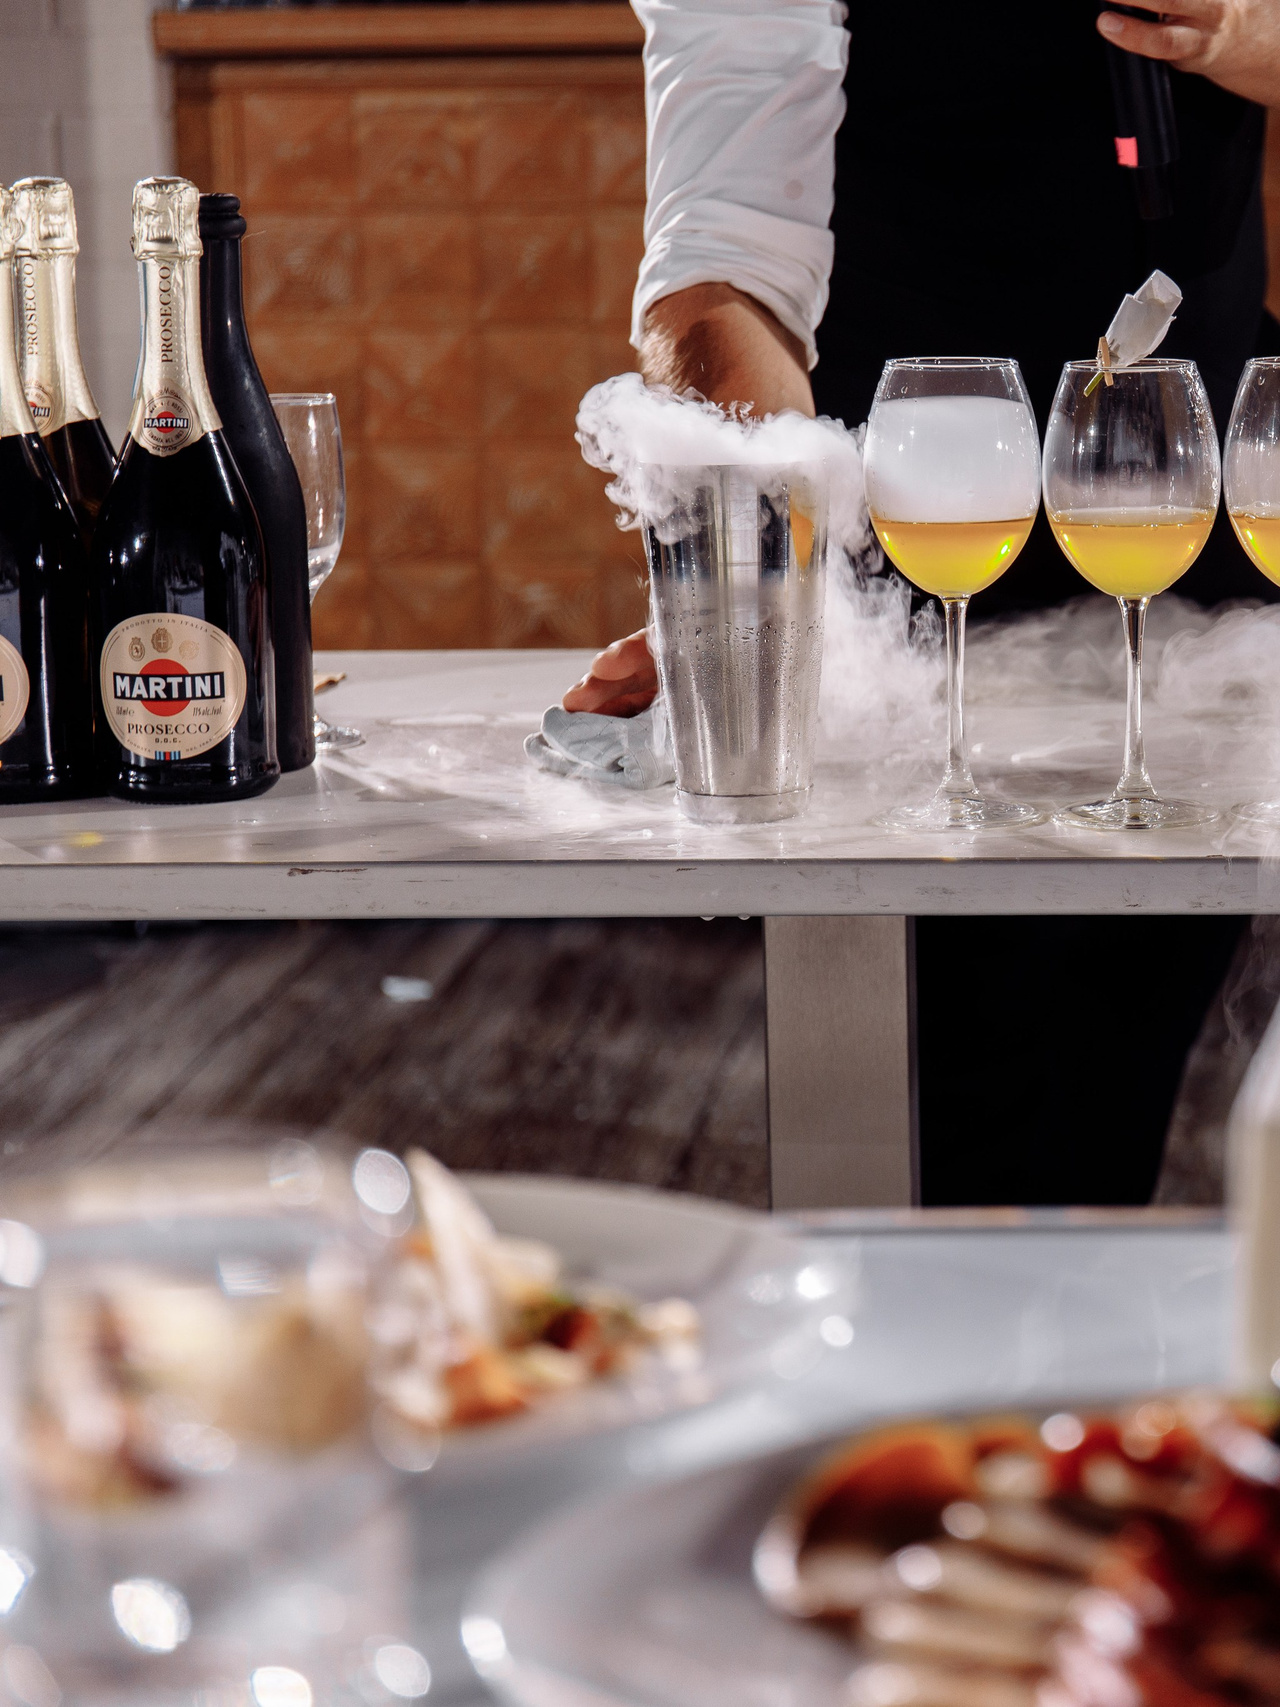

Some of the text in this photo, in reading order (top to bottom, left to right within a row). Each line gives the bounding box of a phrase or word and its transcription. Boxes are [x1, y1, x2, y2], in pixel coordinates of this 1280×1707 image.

[23, 262, 39, 356] PROSECCO
[158, 266, 173, 363] PROSECCO
[144, 418, 188, 428] MARTINI
[121, 619, 163, 632] PRODOTTO
[180, 620, 208, 633] ITALIA
[115, 674, 222, 699] MARTINI
[127, 722, 210, 735] PROSECCO
